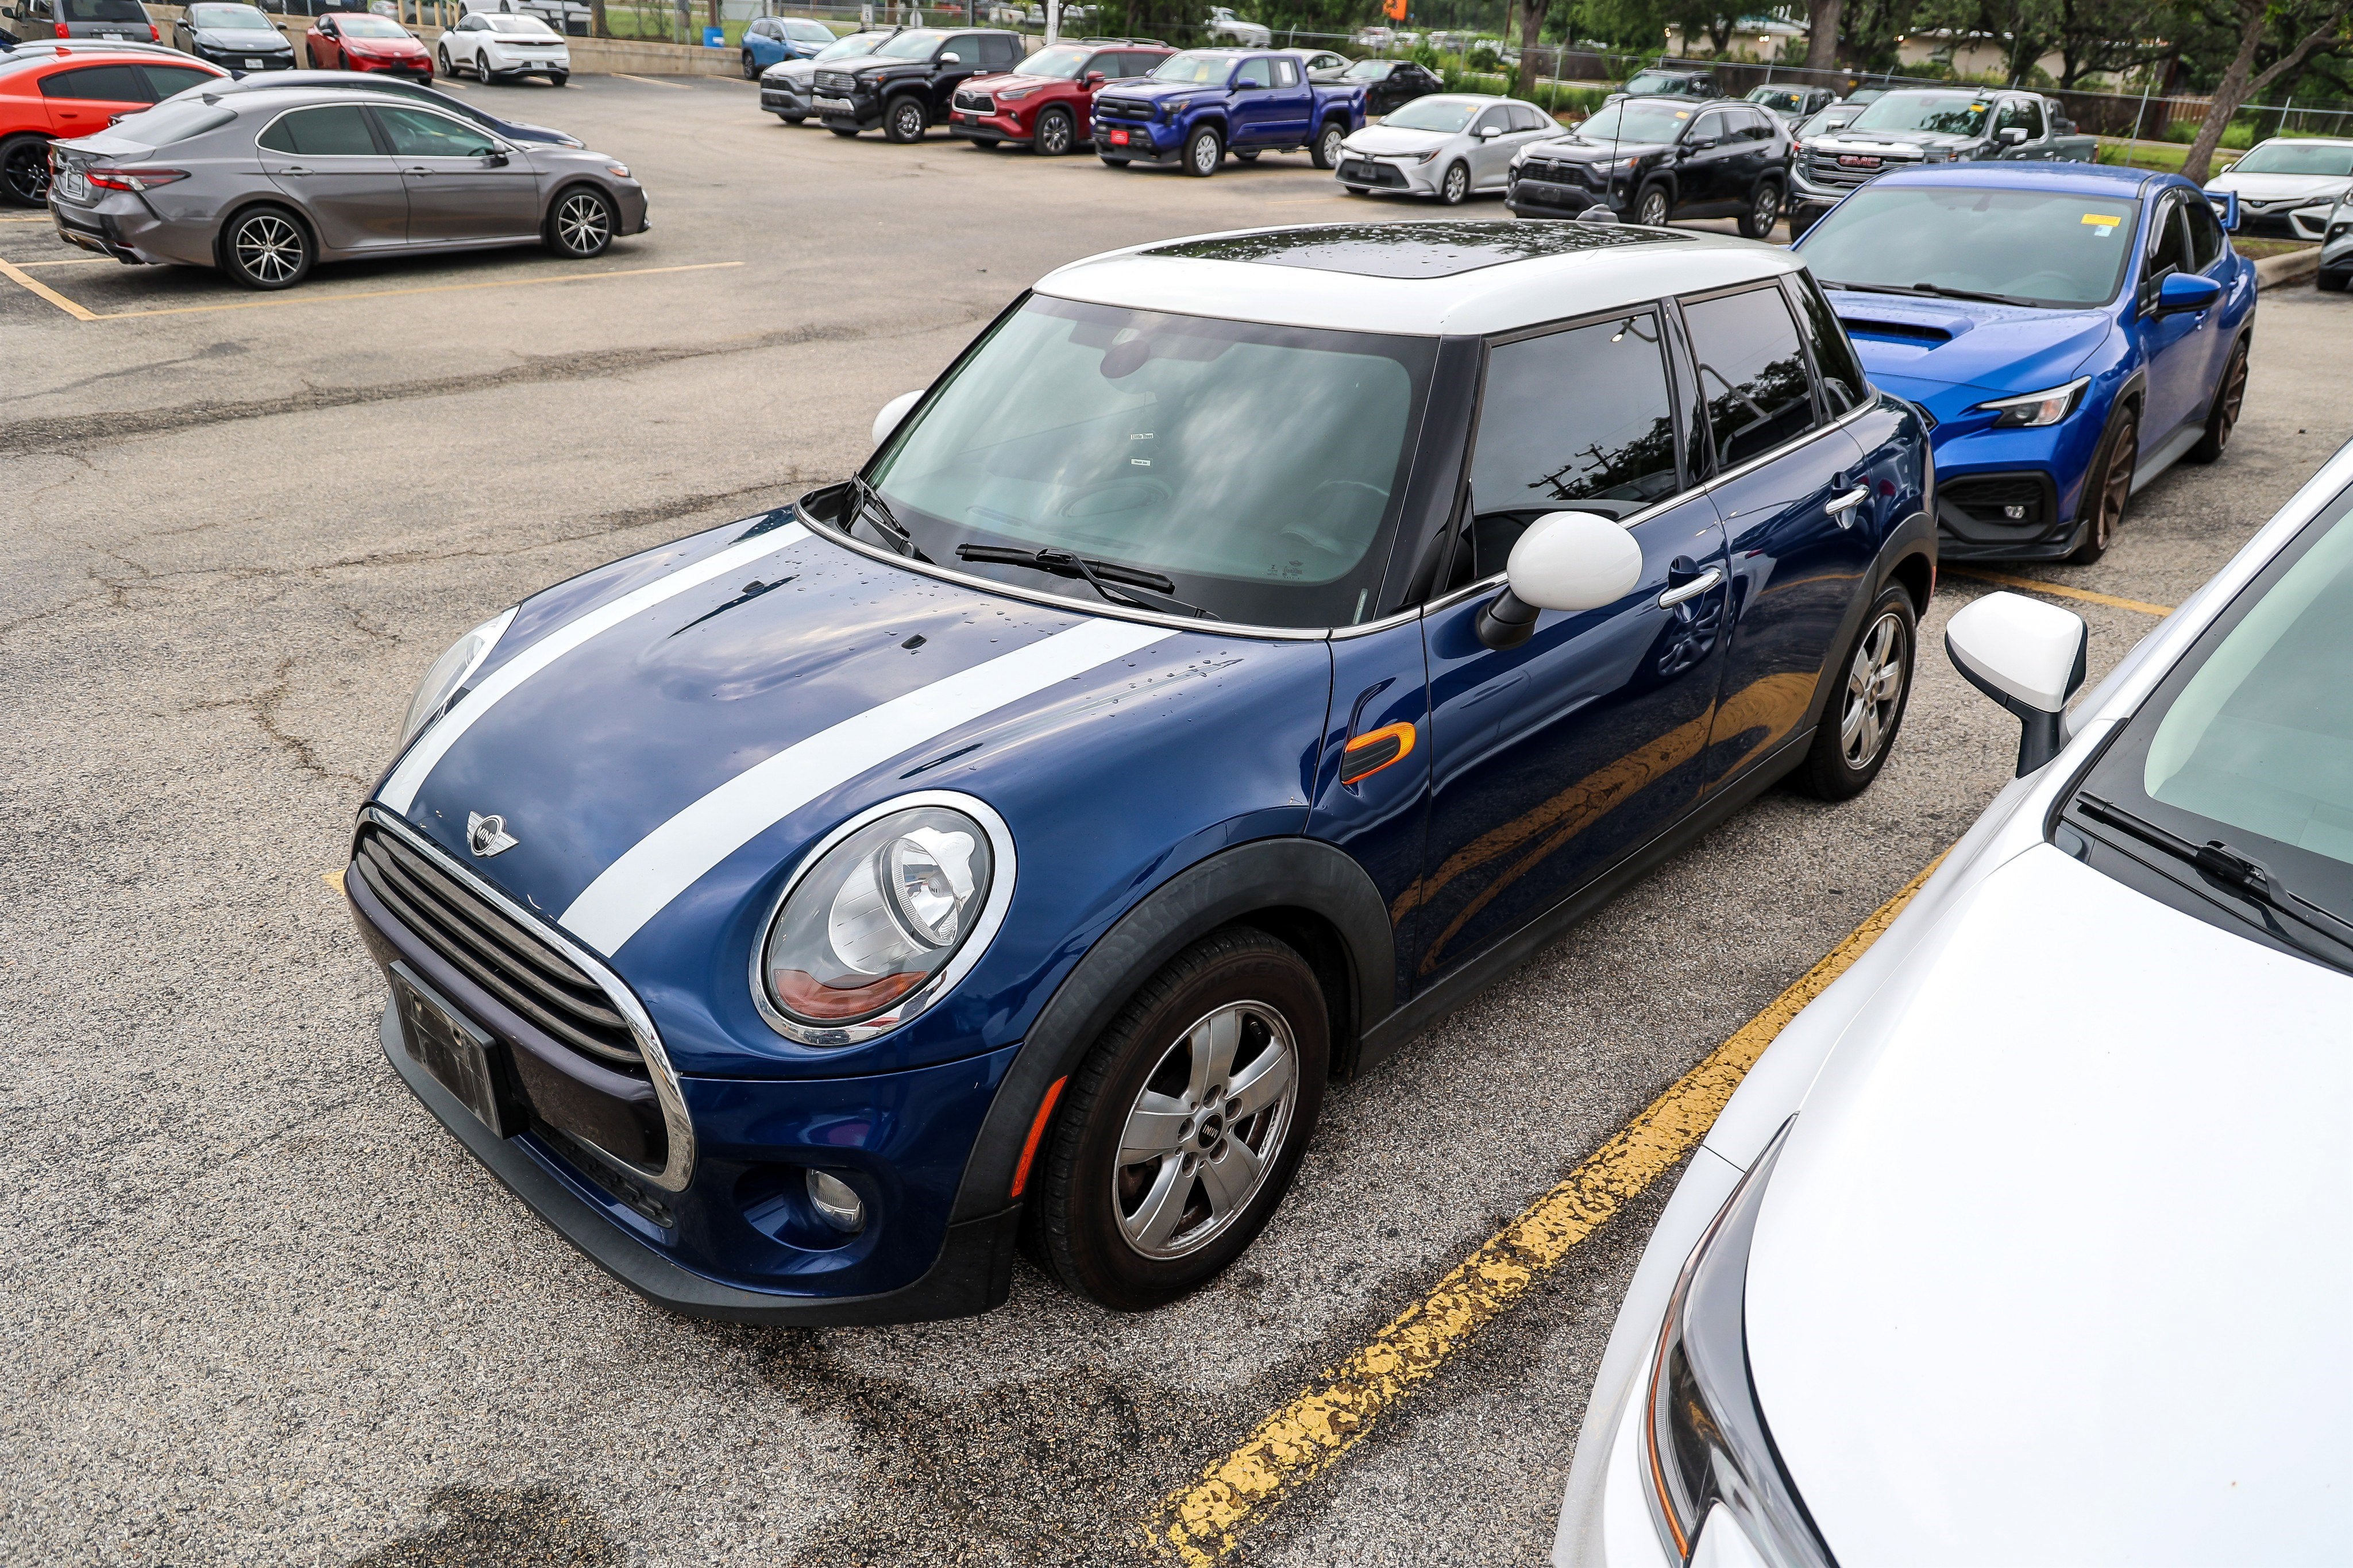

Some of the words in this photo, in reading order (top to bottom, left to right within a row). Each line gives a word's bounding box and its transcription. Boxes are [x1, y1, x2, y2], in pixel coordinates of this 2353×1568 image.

[1839, 155, 1881, 168] GMC
[476, 825, 495, 844] MINI
[1202, 1124, 1219, 1138] MINI
